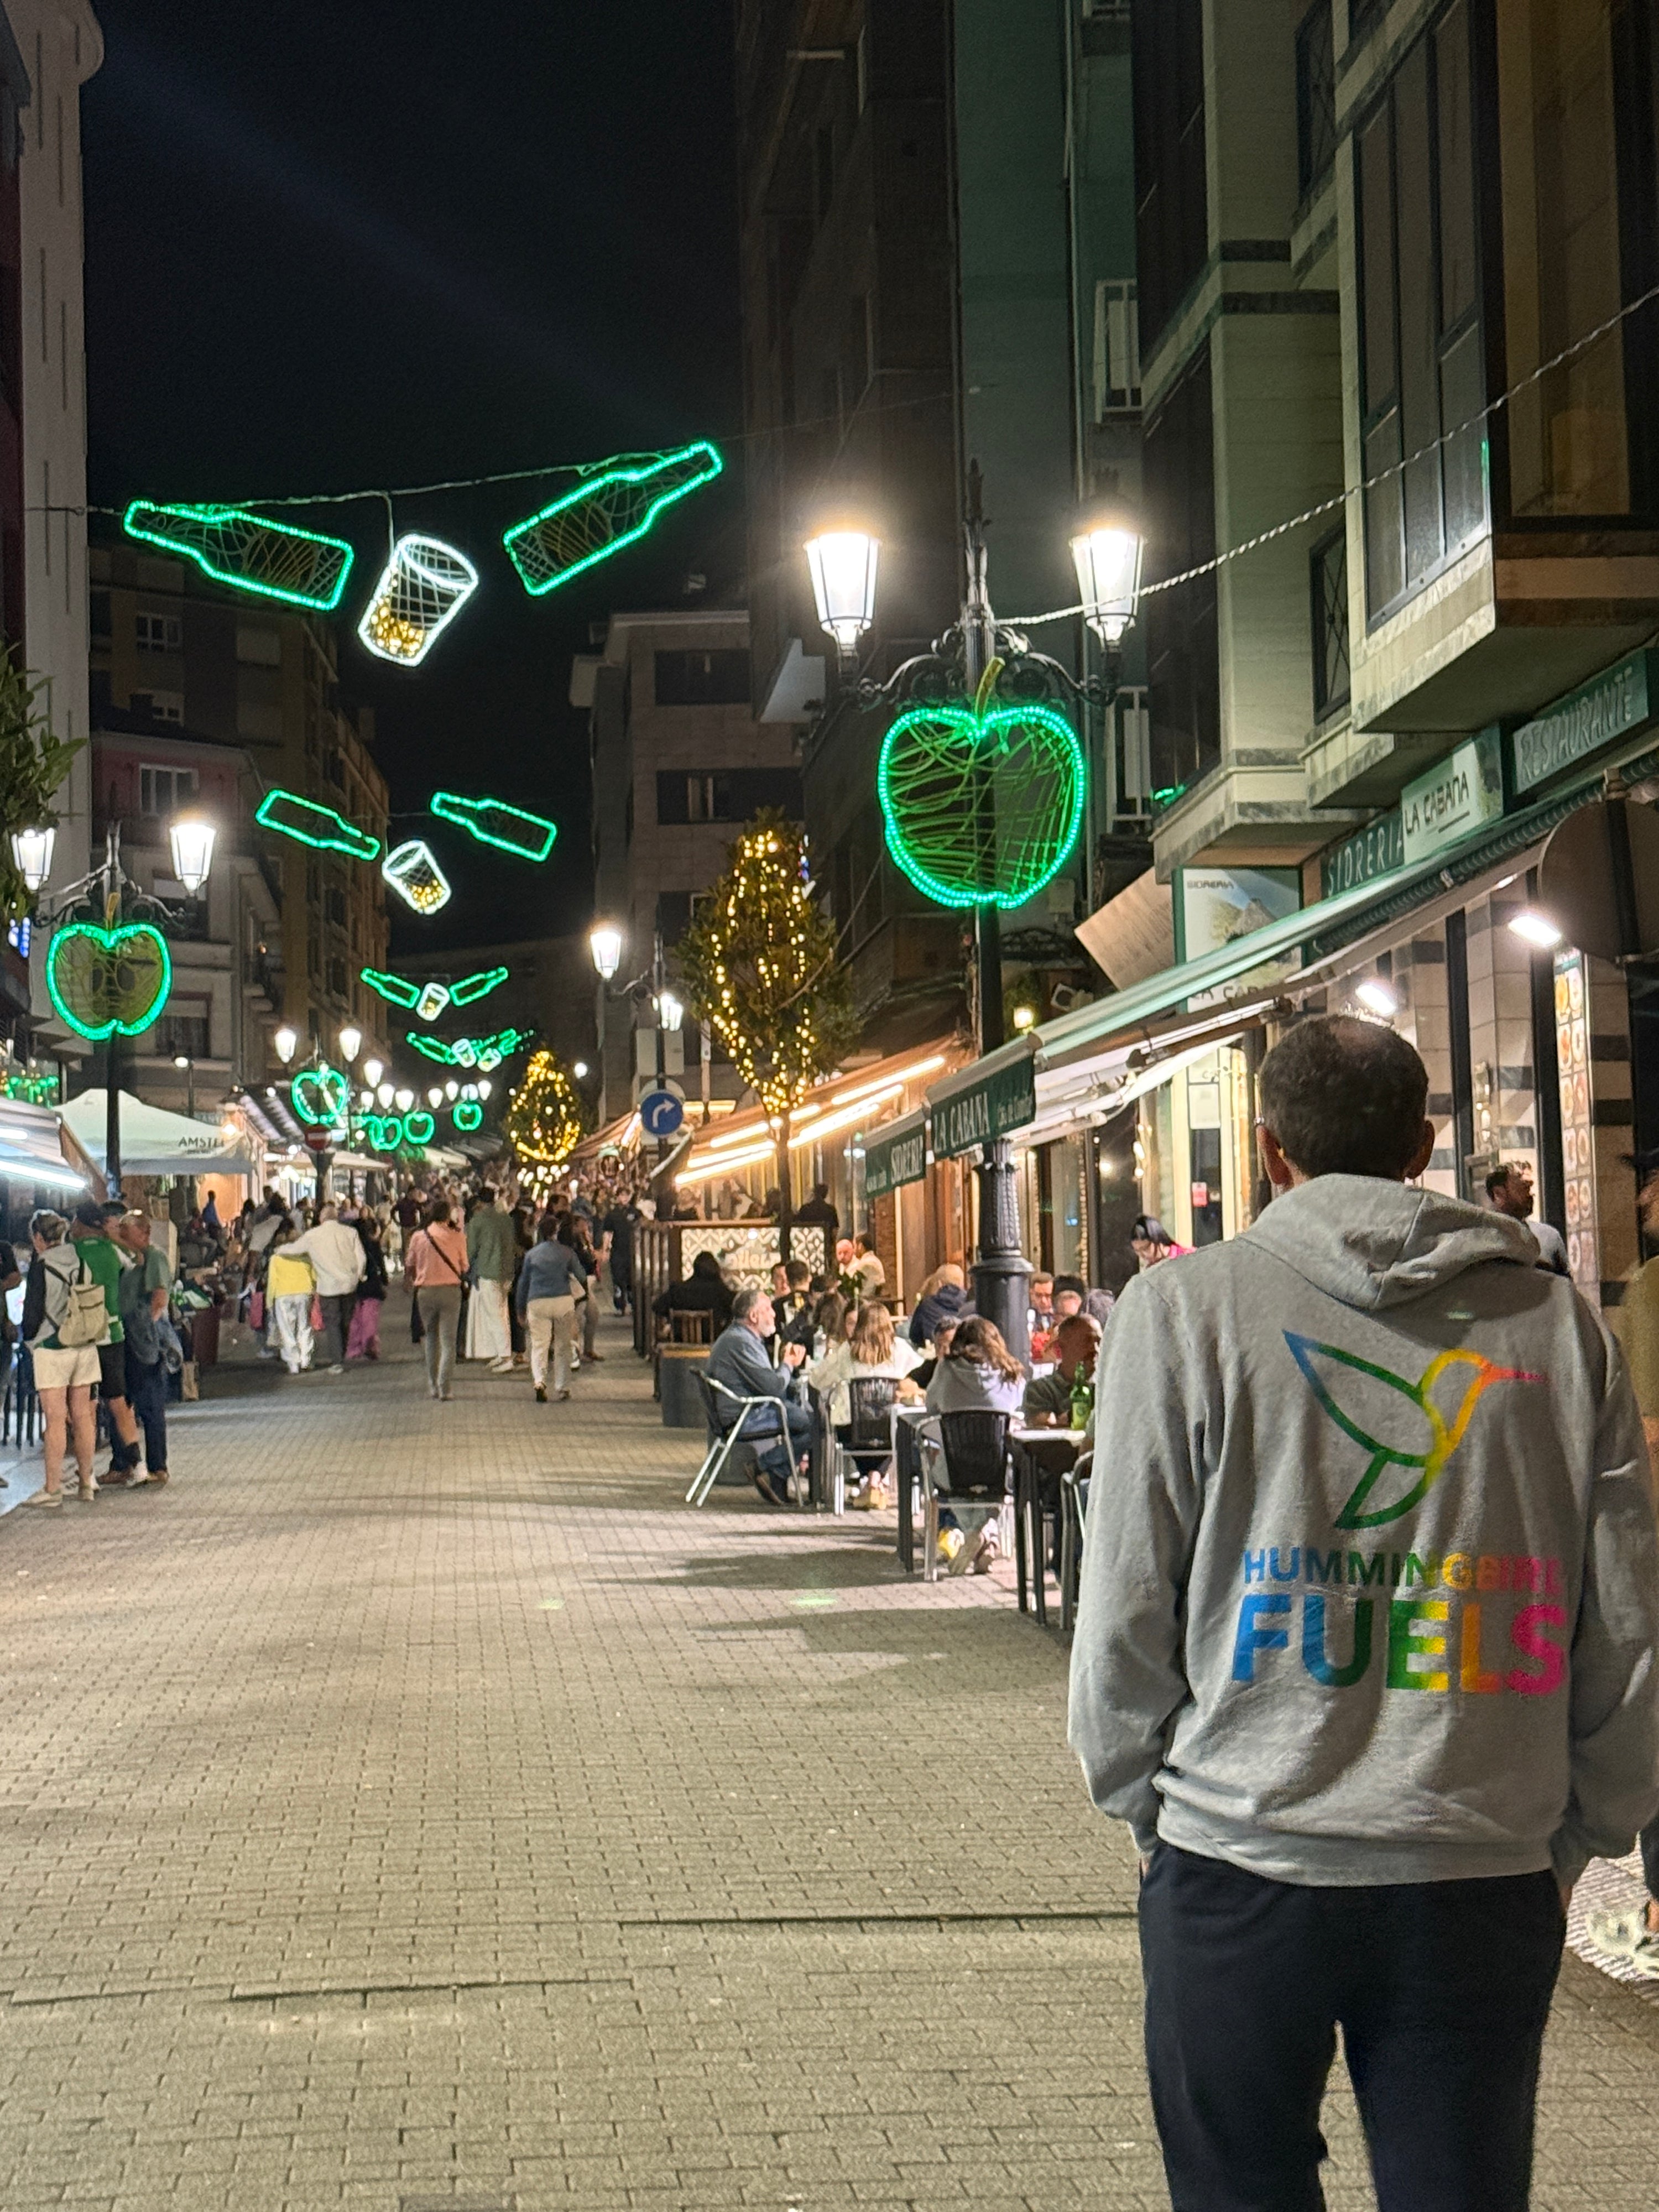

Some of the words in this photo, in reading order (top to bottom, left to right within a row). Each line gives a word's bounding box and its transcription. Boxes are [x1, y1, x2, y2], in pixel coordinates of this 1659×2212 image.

[1405, 803, 1420, 836] LA
[934, 1113, 947, 1152] LA
[1232, 1593, 1566, 1695] FUELS
